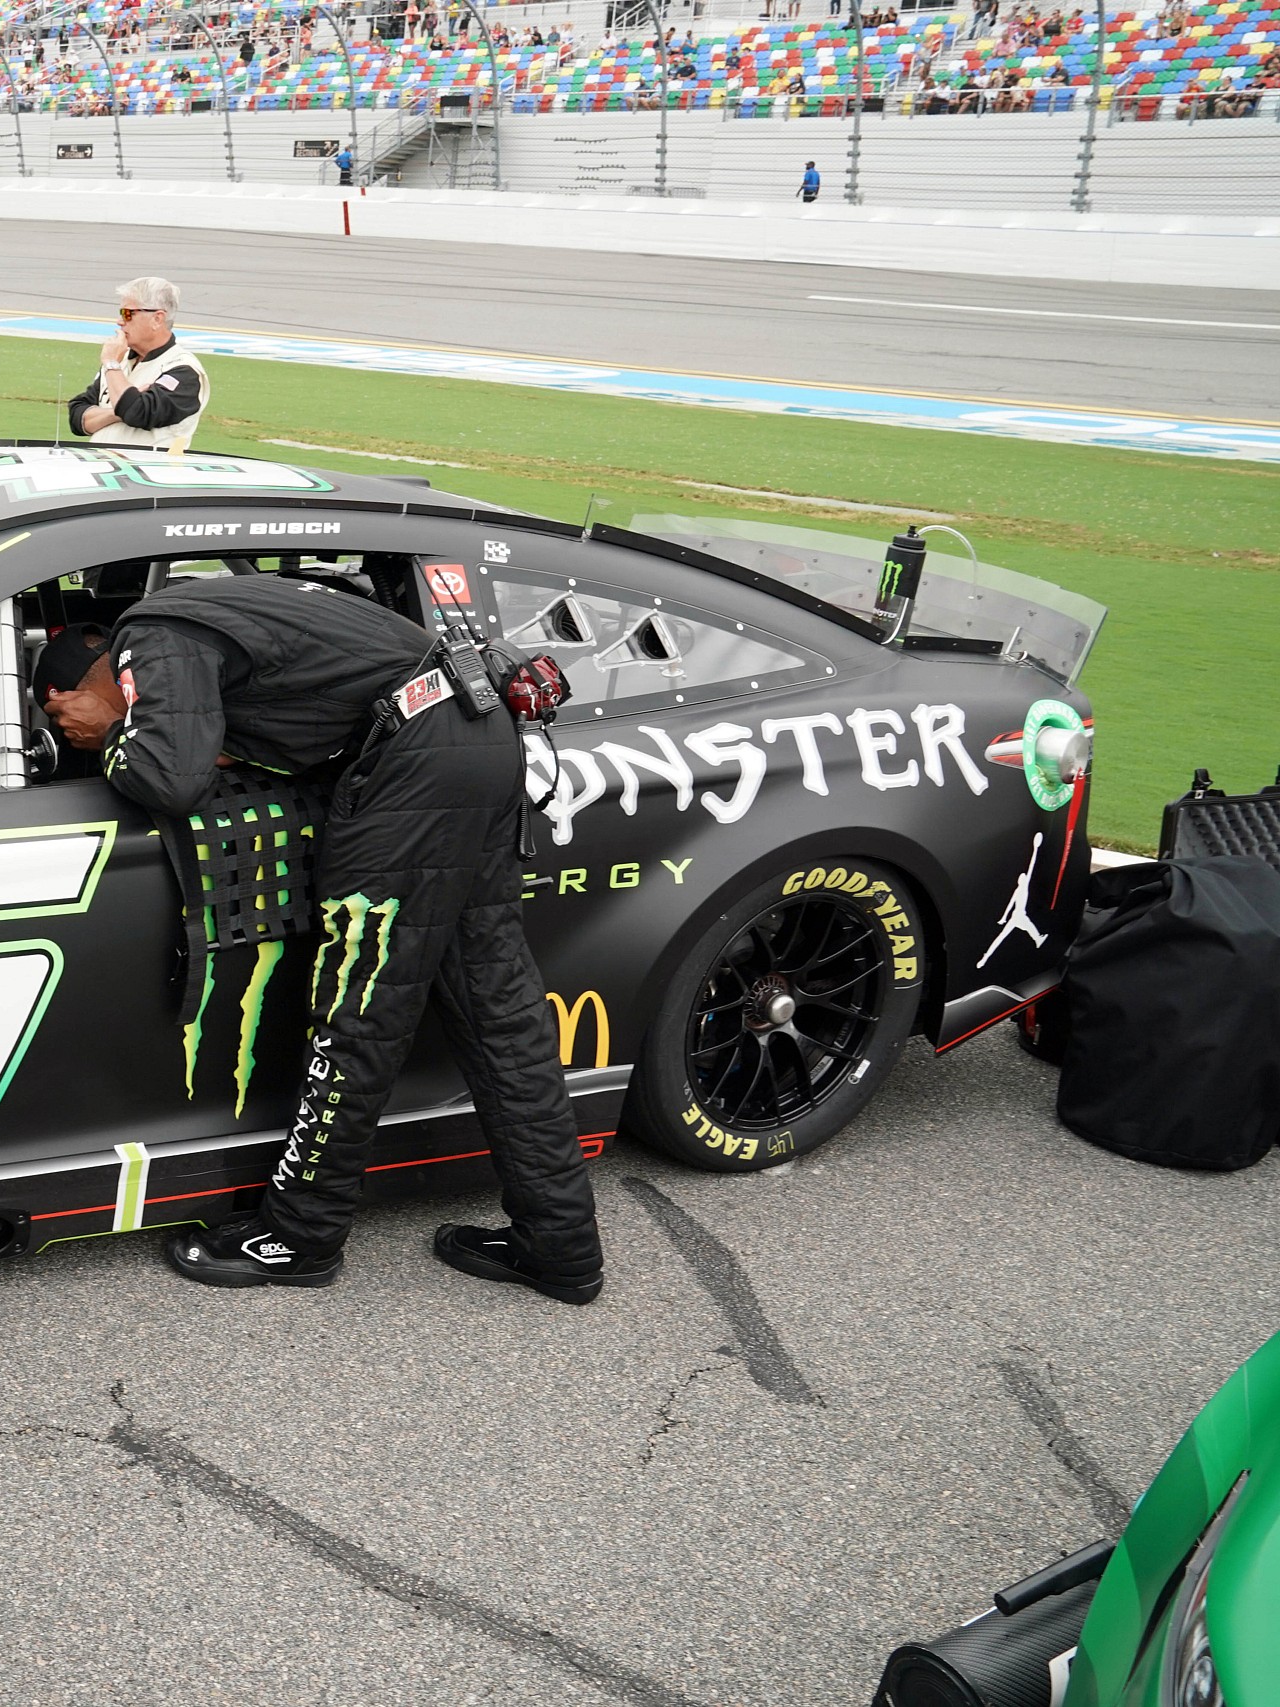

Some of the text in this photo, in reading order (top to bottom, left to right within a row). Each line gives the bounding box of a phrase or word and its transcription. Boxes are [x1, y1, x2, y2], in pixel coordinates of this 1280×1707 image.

[162, 522, 341, 537] KURT BUSCH
[524, 703, 989, 845] ONSTER
[782, 867, 919, 982] GOODYEAR
[301, 1069, 346, 1182] ENERGY
[681, 1102, 760, 1161] EAGLE
